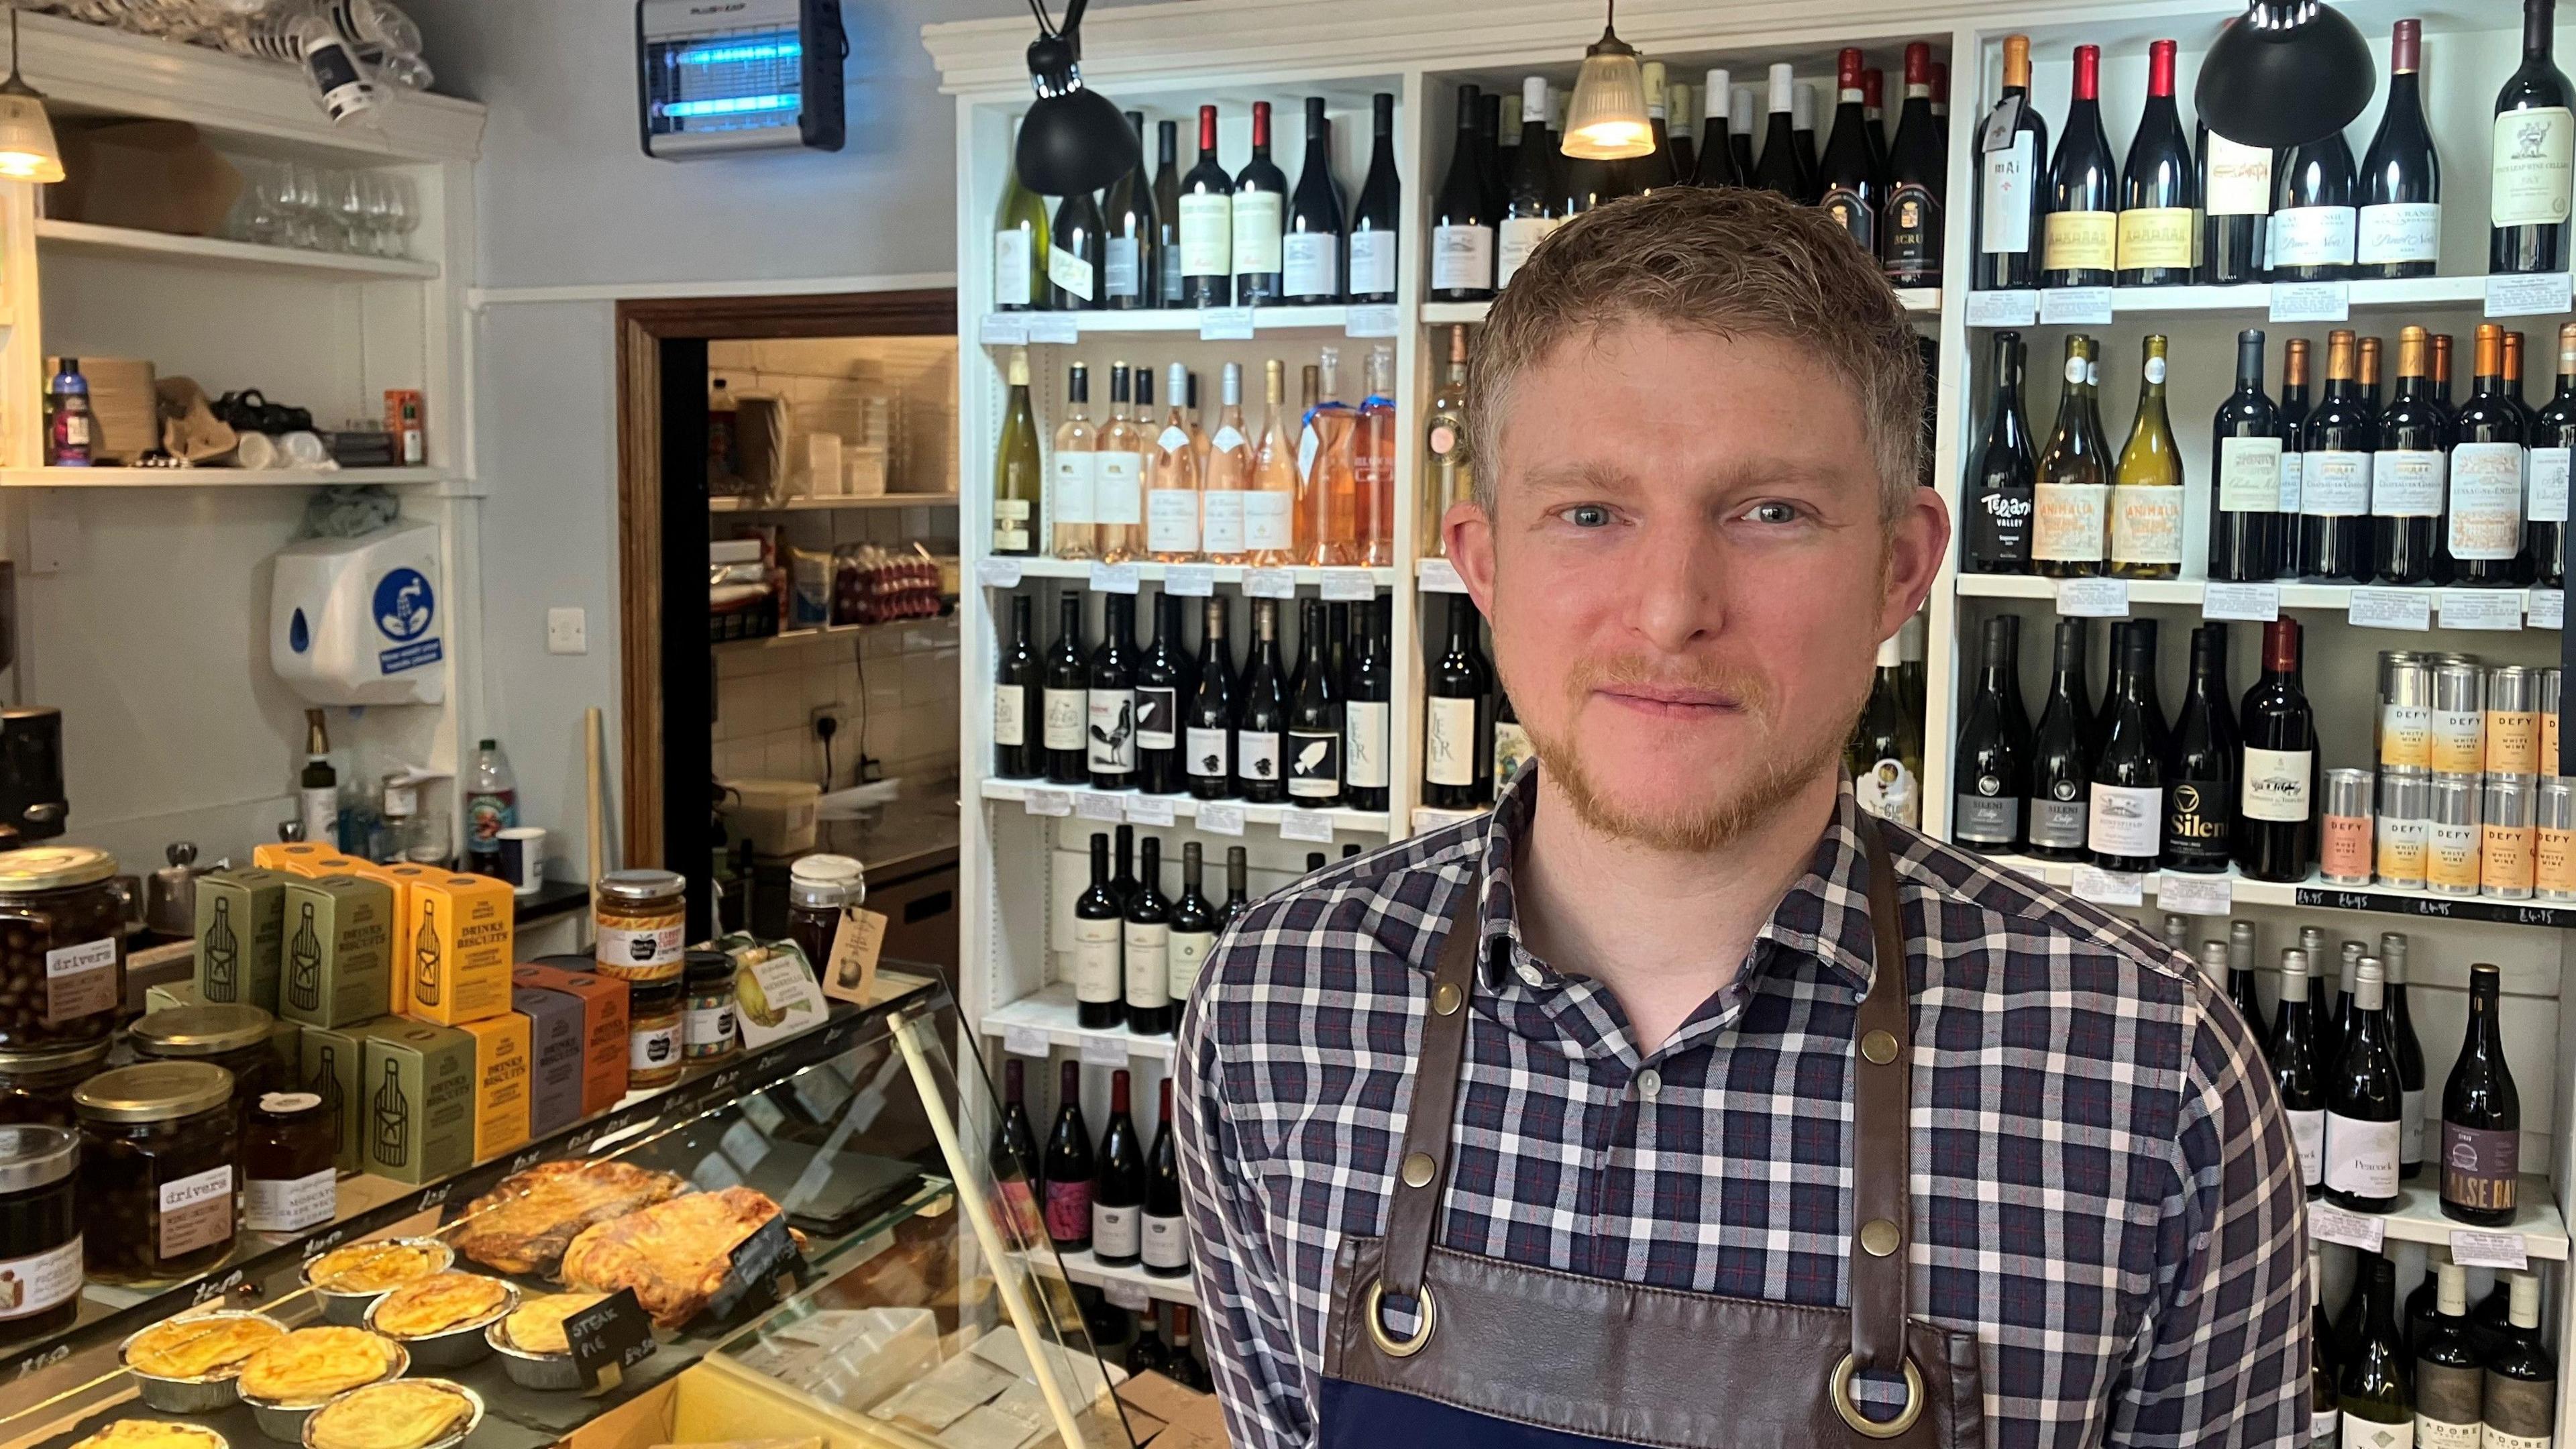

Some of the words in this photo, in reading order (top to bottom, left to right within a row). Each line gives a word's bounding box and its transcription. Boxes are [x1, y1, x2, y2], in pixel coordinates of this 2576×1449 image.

[1996, 519, 2023, 527] VALLEY
[2396, 710, 2428, 719] DEFY
[2450, 717, 2481, 726] DEFY
[2499, 717, 2532, 726] DEFY
[2331, 821, 2363, 832] DEFY
[2392, 824, 2423, 833] DEFY
[2438, 830, 2471, 839] DEFY
[2489, 831, 2522, 841] DEFY
[2538, 833, 2570, 843] DEFY
[2339, 894, 2367, 909] £4.95
[2420, 901, 2452, 916] £4.95
[2520, 908, 2554, 923] £4.95
[52, 949, 111, 971] drivers
[2355, 1159, 2392, 1171] Peacock
[166, 1179, 227, 1205] drivers
[572, 1307, 618, 1338] STEAK
[581, 1334, 606, 1358] PIE
[2426, 1422, 2477, 1436] ADOBE
[2488, 1432, 2542, 1448] ADOBE
